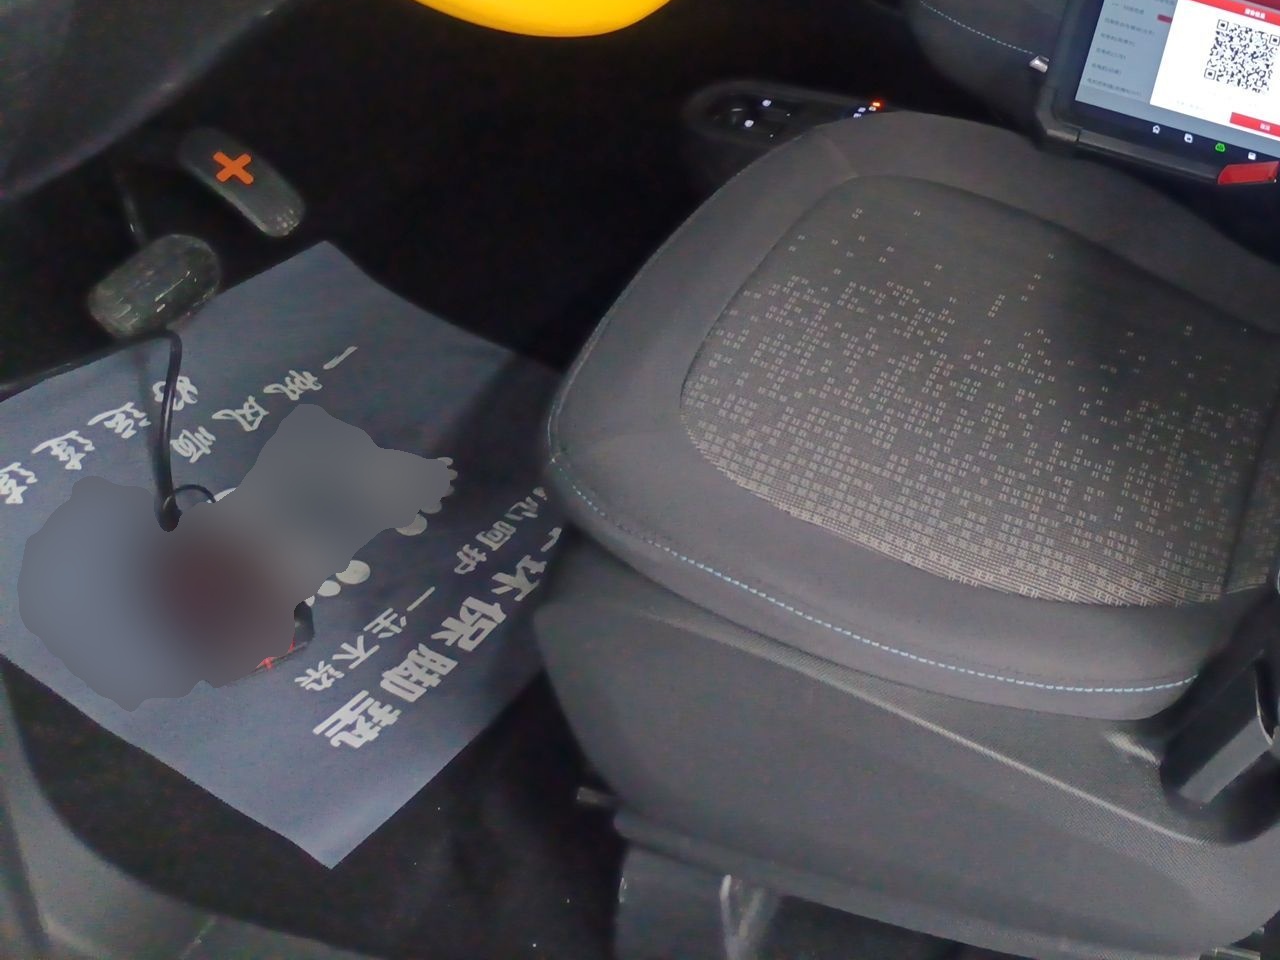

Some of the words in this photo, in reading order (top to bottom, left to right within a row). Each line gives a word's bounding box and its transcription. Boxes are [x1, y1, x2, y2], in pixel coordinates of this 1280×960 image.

[170, 346, 357, 463] 一帆风顺
[454, 486, 548, 575] 心呵护
[294, 586, 436, 691] 一尘不染
[312, 527, 562, 749] 环保脚垫
